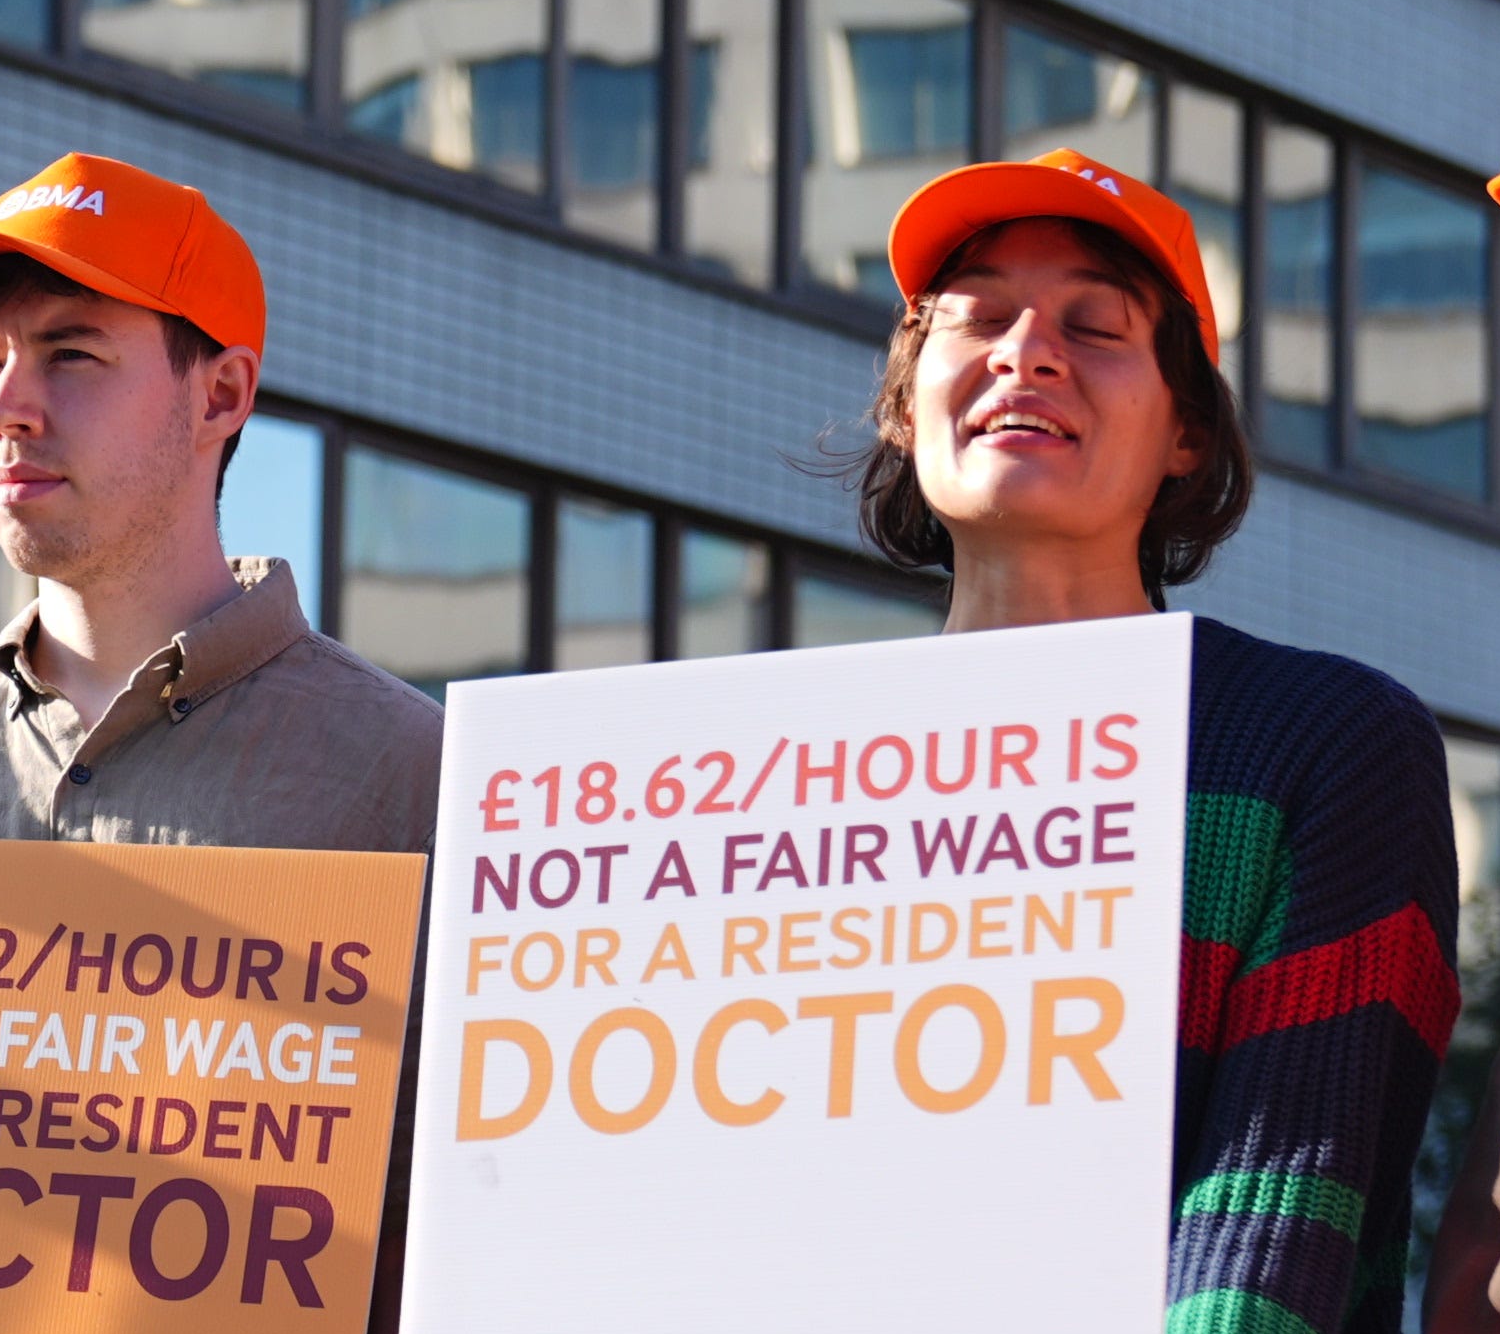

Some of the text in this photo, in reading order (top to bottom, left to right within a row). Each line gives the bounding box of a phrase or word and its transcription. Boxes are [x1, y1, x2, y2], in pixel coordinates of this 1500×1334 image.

[23, 184, 104, 216] BMA
[480, 713, 1139, 833] £18.62/HOUR IS
[472, 801, 1135, 914] NOT A FAIR WAGE
[303, 941, 372, 1006] IS
[466, 887, 1134, 996] FOR A RESIDENT
[164, 1017, 361, 1086] WAGE
[456, 976, 1123, 1143] DOCTOR
